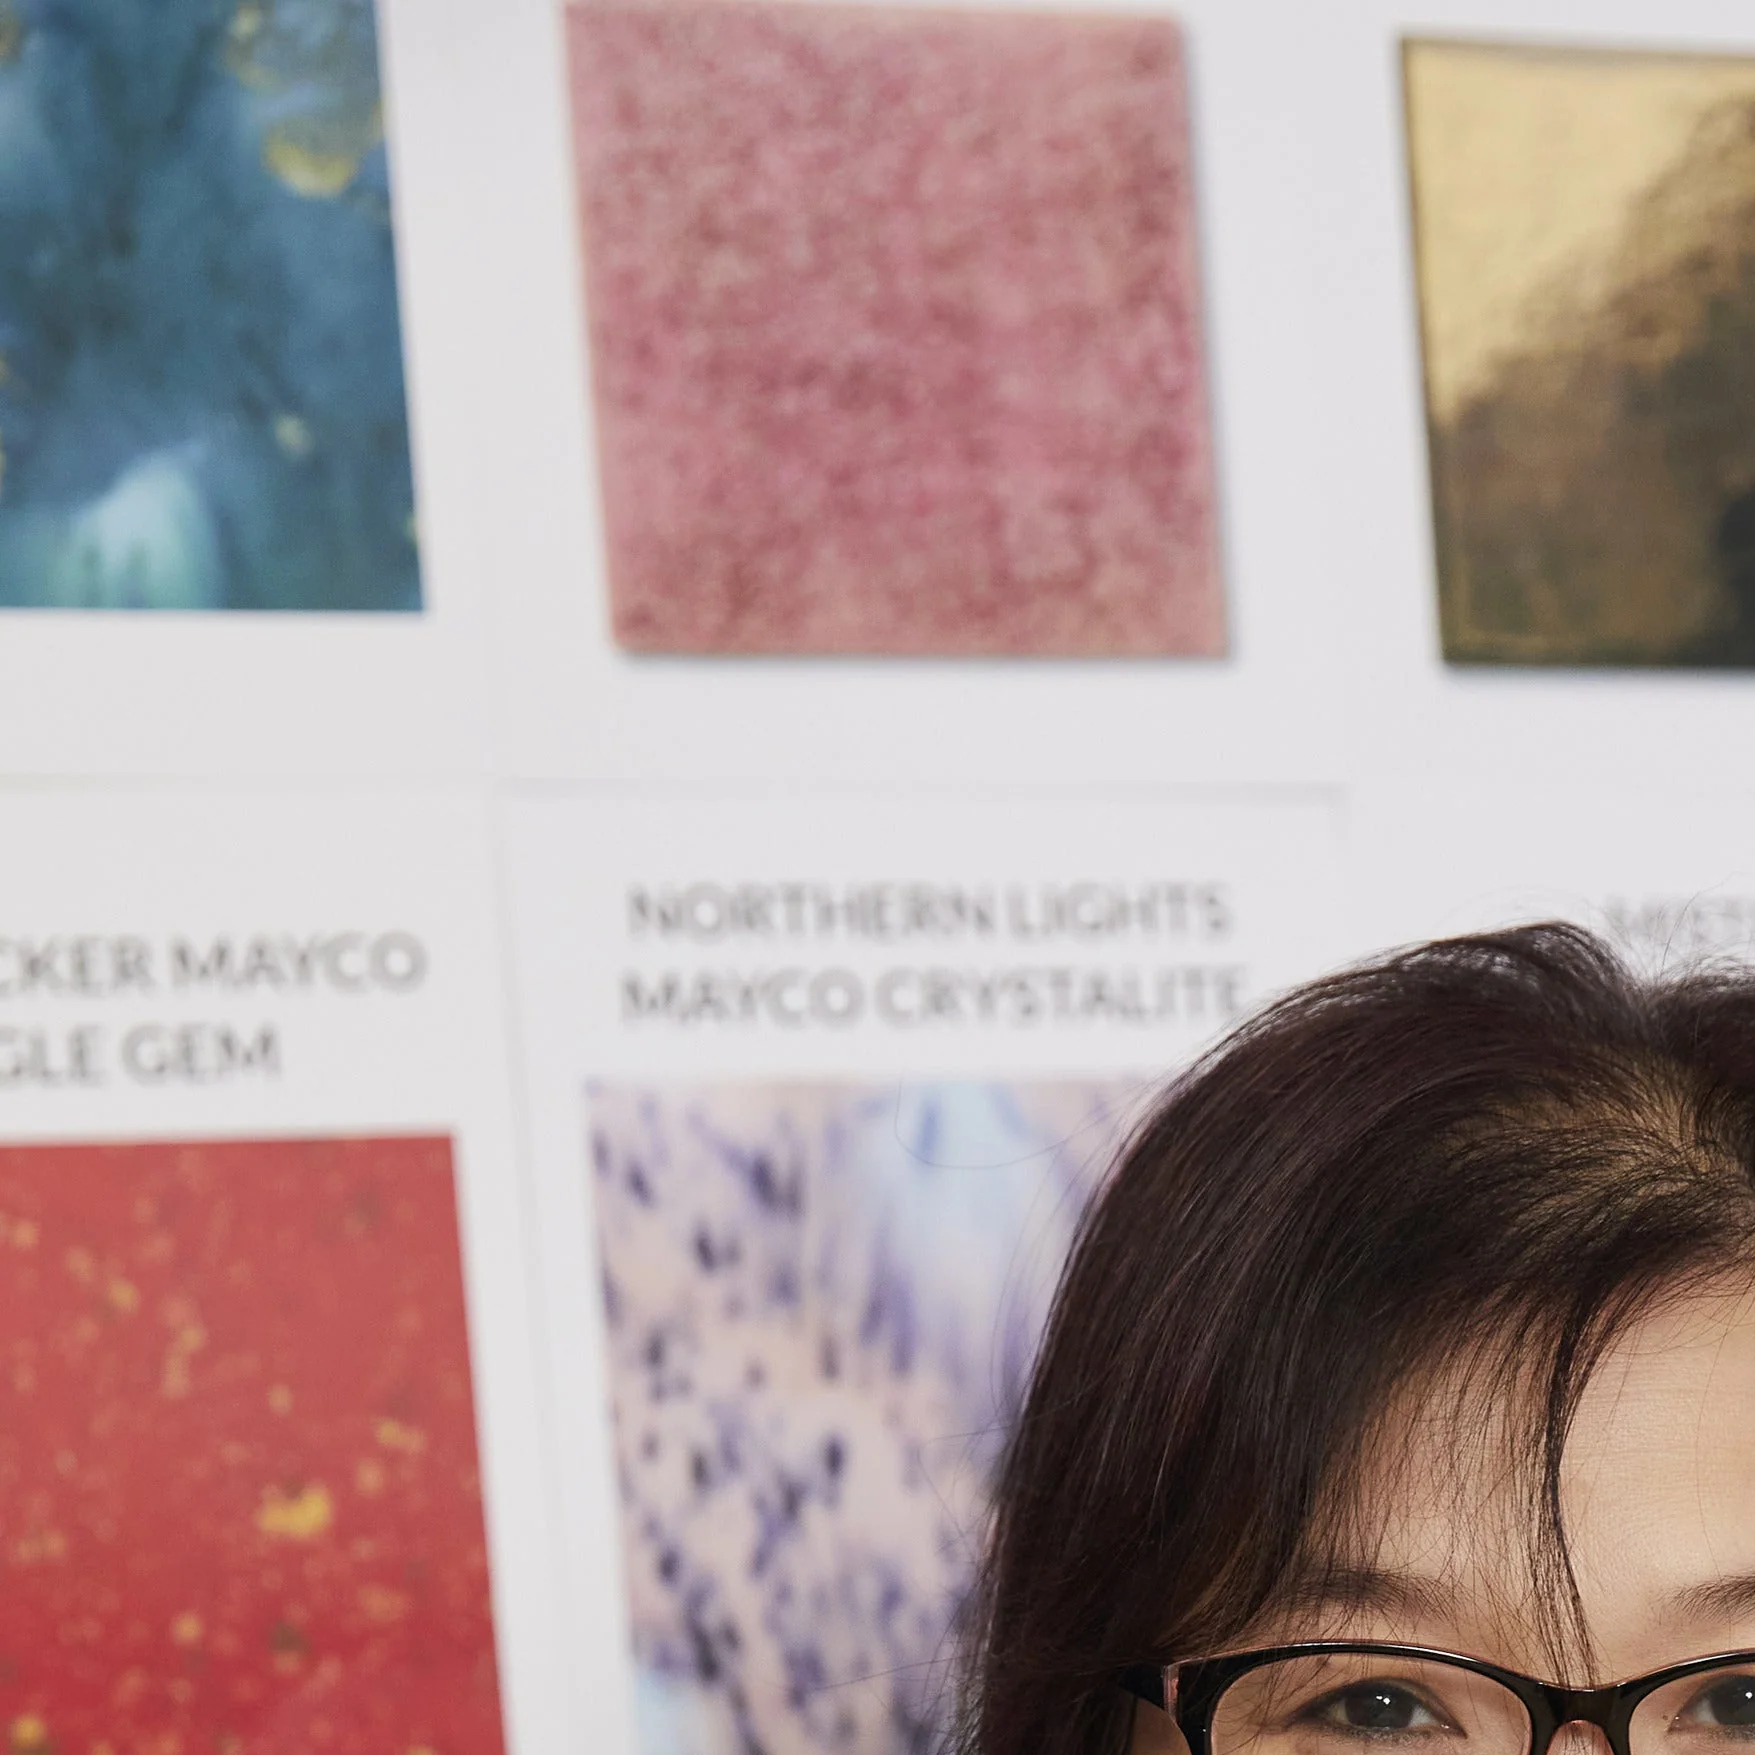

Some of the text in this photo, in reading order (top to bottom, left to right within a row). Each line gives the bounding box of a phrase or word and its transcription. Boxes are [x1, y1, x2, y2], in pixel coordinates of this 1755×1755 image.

[624, 880, 1236, 945] NORTHERN LIGHTS
[168, 930, 430, 995] MAYCO
[616, 964, 1248, 1031] MAYCO CRYSTALITE
[116, 1020, 285, 1087] GEM
